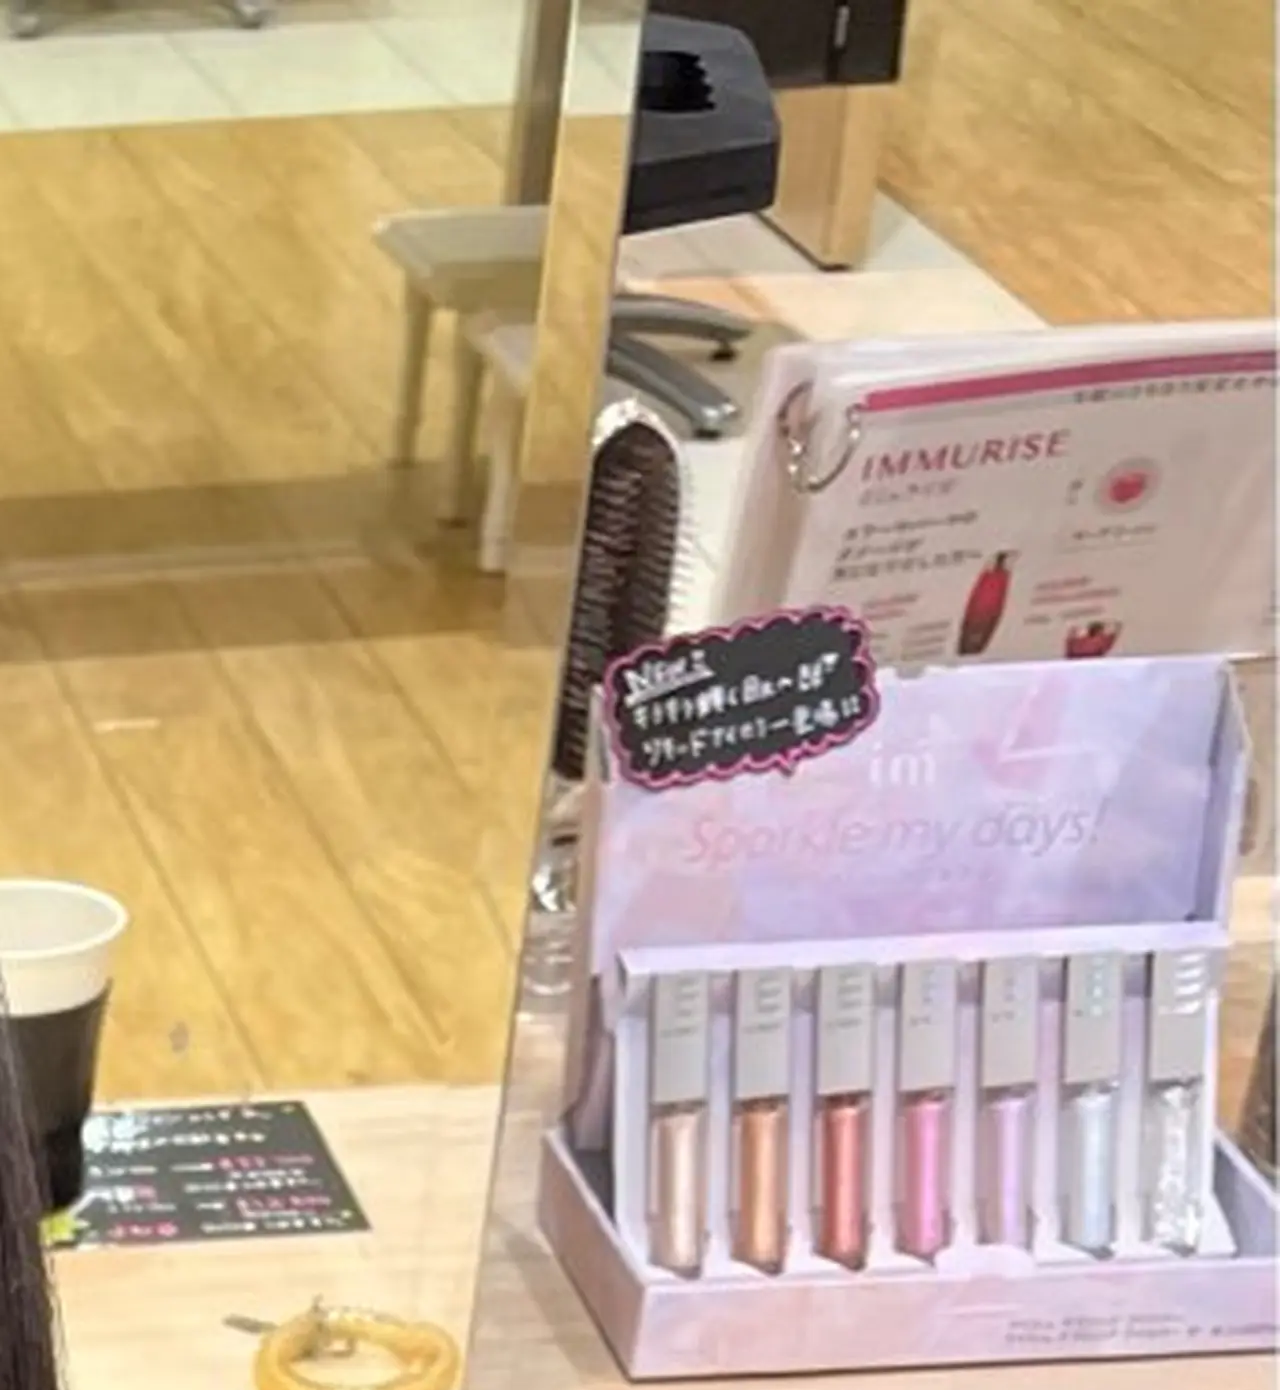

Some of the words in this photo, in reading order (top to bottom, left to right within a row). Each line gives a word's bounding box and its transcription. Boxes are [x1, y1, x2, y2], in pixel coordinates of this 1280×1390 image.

[860, 429, 1071, 481] IMMURISE
[684, 814, 868, 870] Sparkle
[884, 812, 962, 857] my
[972, 797, 1109, 857] days!
